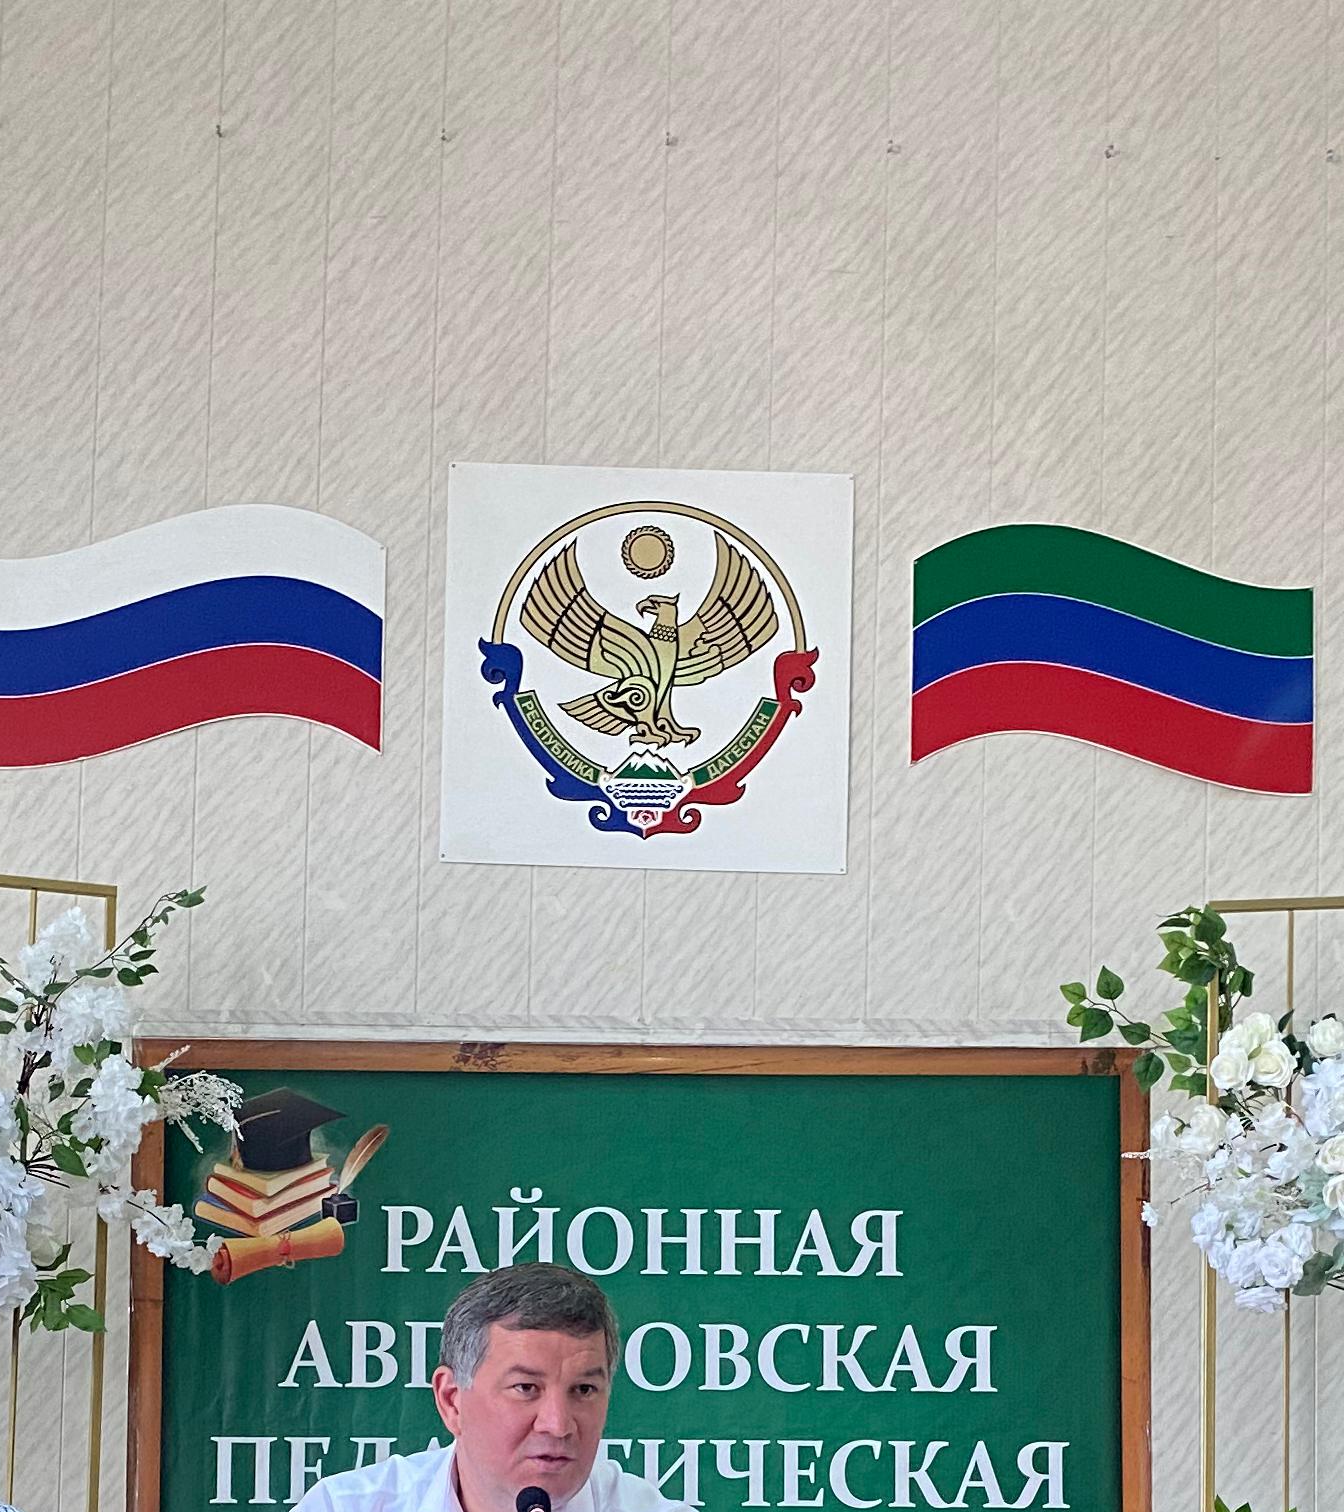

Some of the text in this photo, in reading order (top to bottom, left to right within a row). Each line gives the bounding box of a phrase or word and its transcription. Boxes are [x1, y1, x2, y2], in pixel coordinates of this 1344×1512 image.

[520, 698, 771, 780] РЕСПУБЛИКА ДАГЕСТАН
[380, 1186, 904, 1278] РАЙОННАЯ
[277, 1319, 999, 1395] АВГОВСКАЯ
